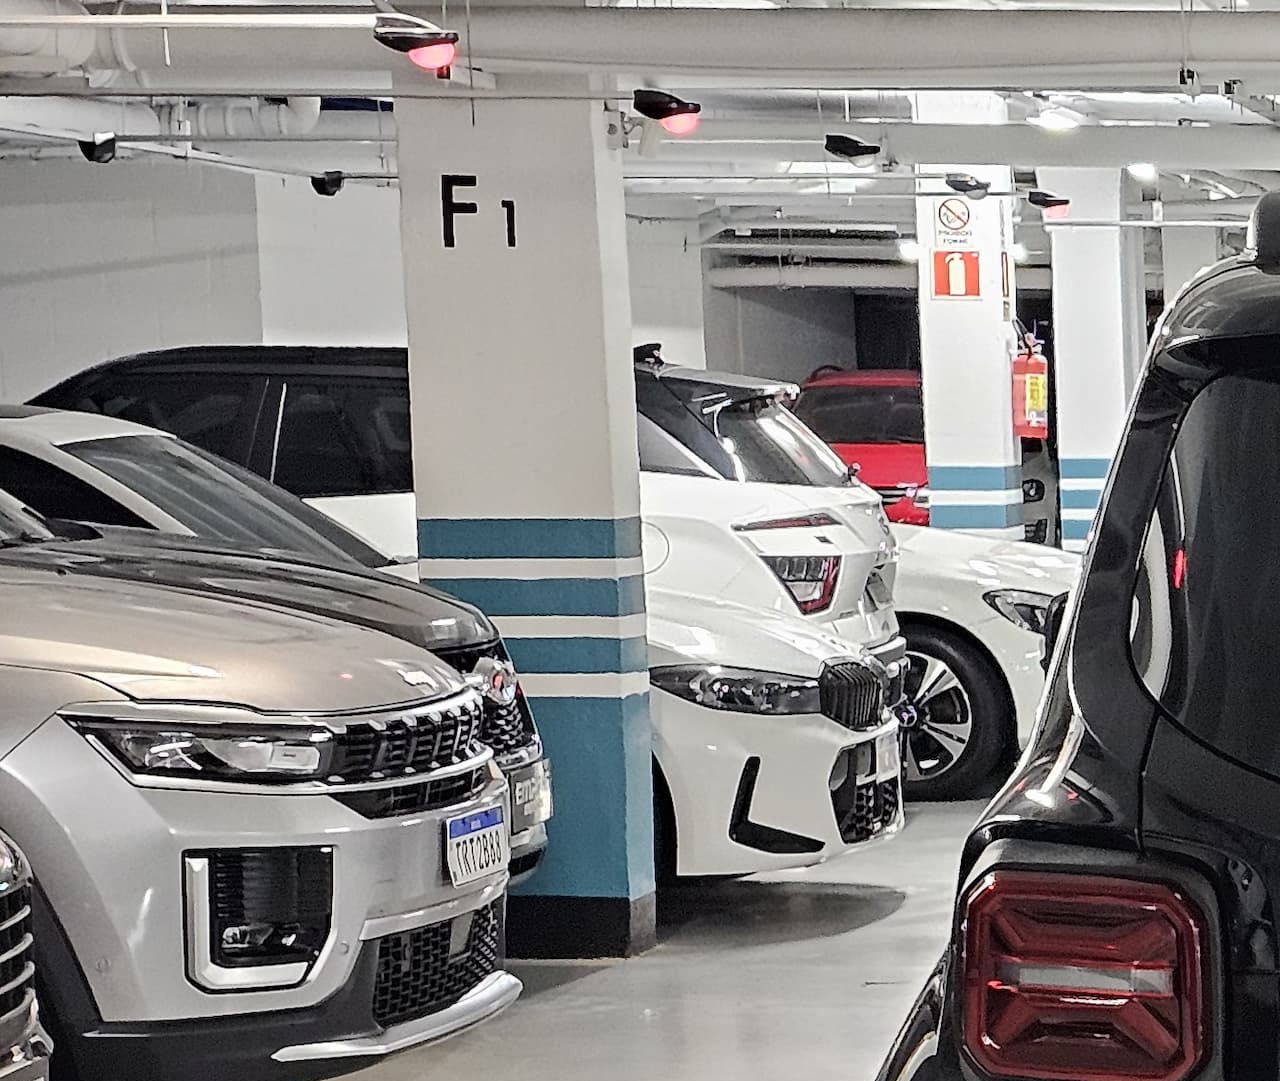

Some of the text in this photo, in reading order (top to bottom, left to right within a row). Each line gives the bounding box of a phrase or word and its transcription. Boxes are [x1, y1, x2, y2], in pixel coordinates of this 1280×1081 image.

[440, 174, 517, 249] F 1
[455, 830, 502, 877] TRT2B88
